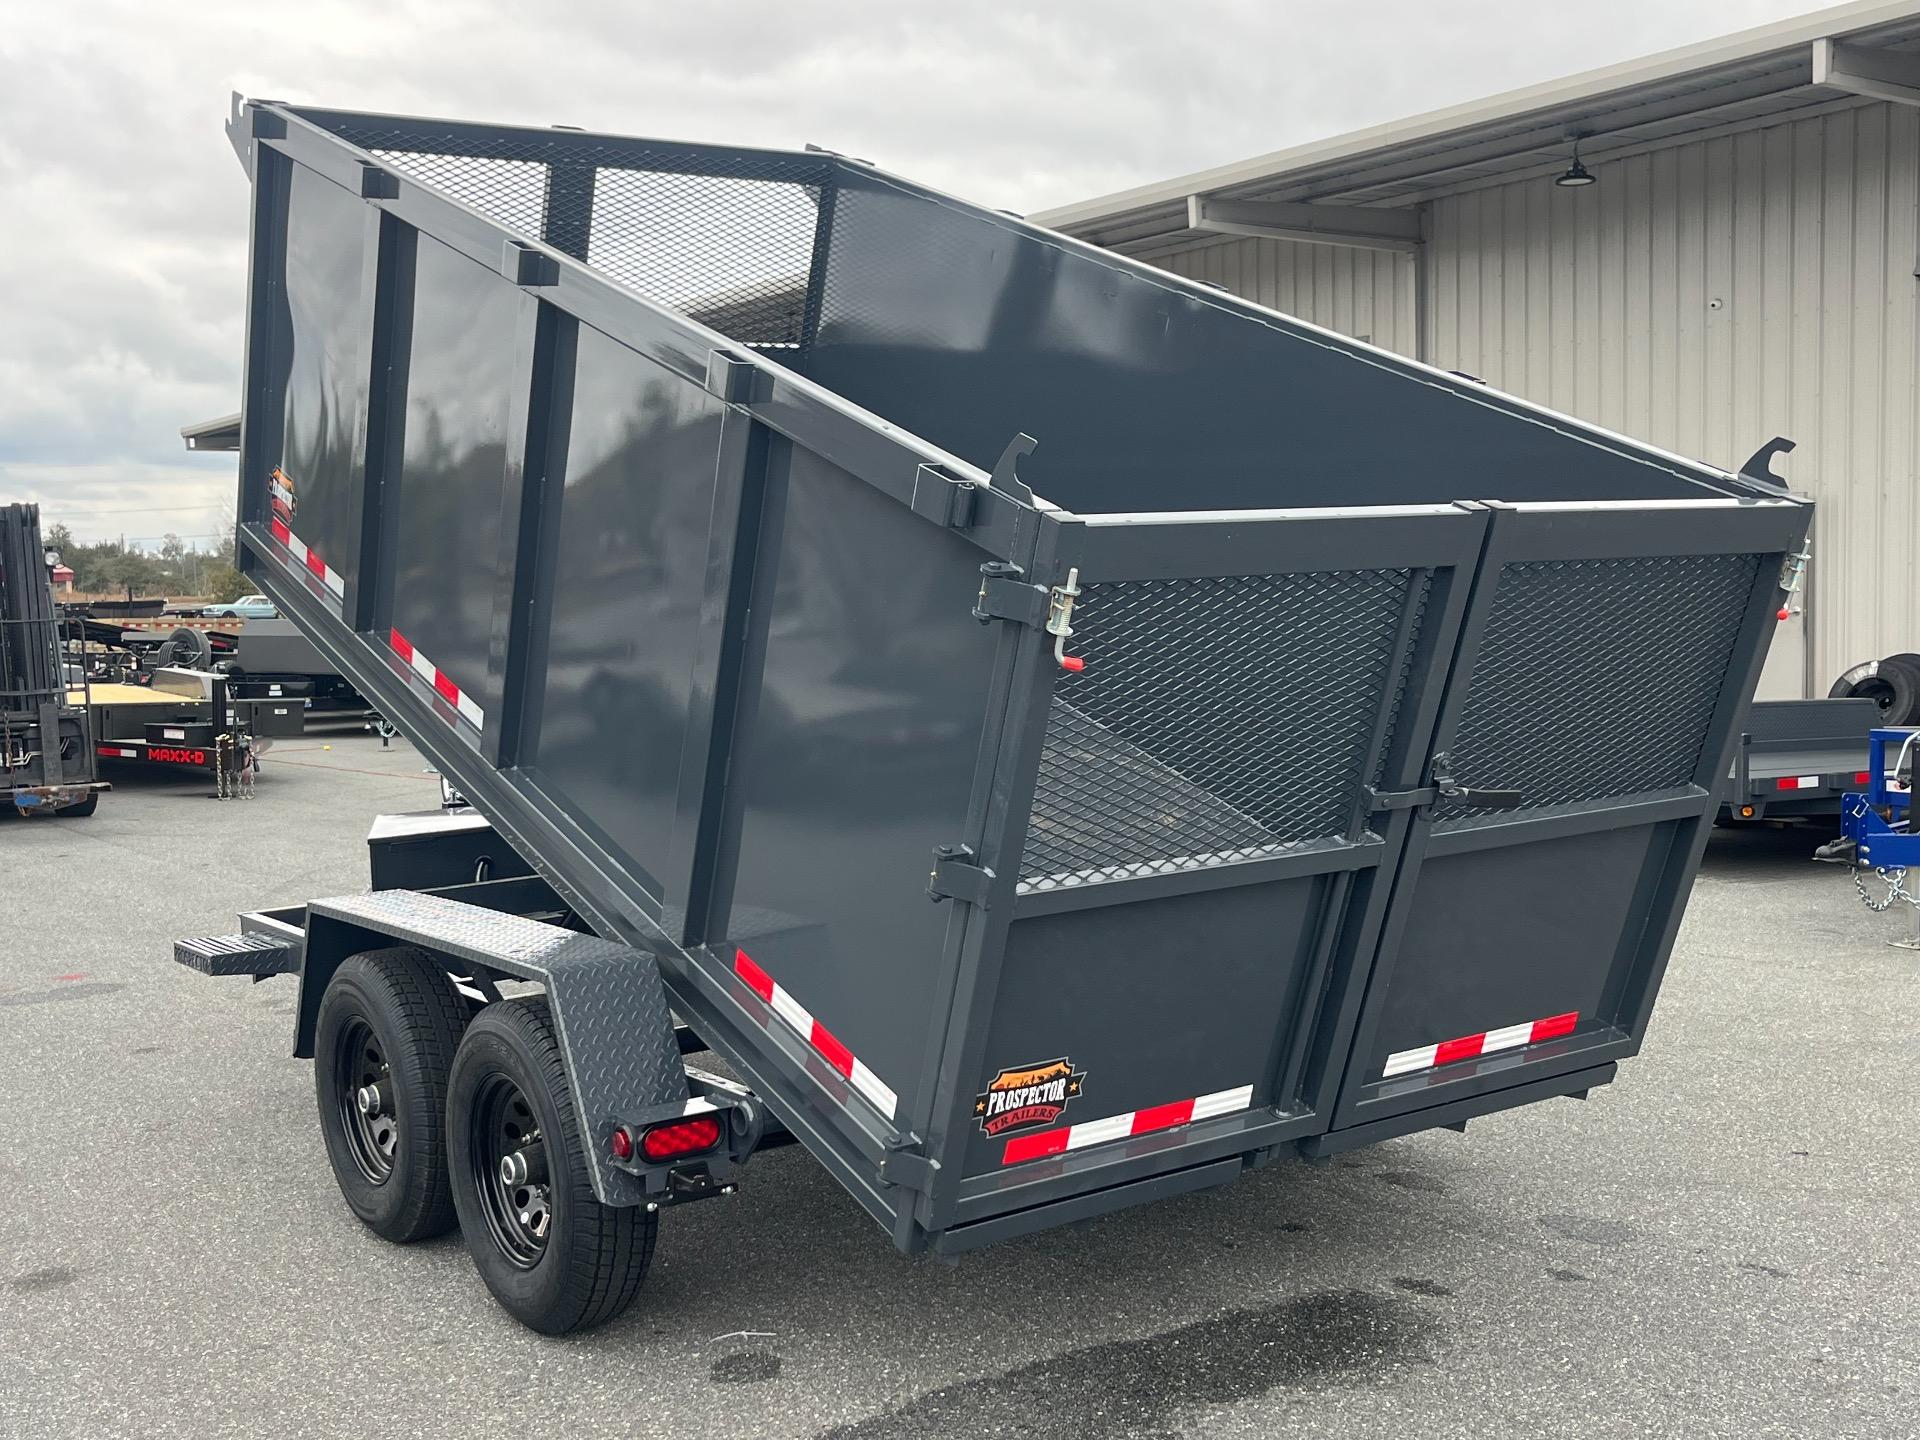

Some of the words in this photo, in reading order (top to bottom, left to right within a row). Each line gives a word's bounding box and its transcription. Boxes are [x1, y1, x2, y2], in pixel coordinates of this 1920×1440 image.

[148, 748, 205, 765] MAXX-D
[986, 1078, 1066, 1116] PROSPECTOR
[991, 1108, 1055, 1130] TRAILERS
